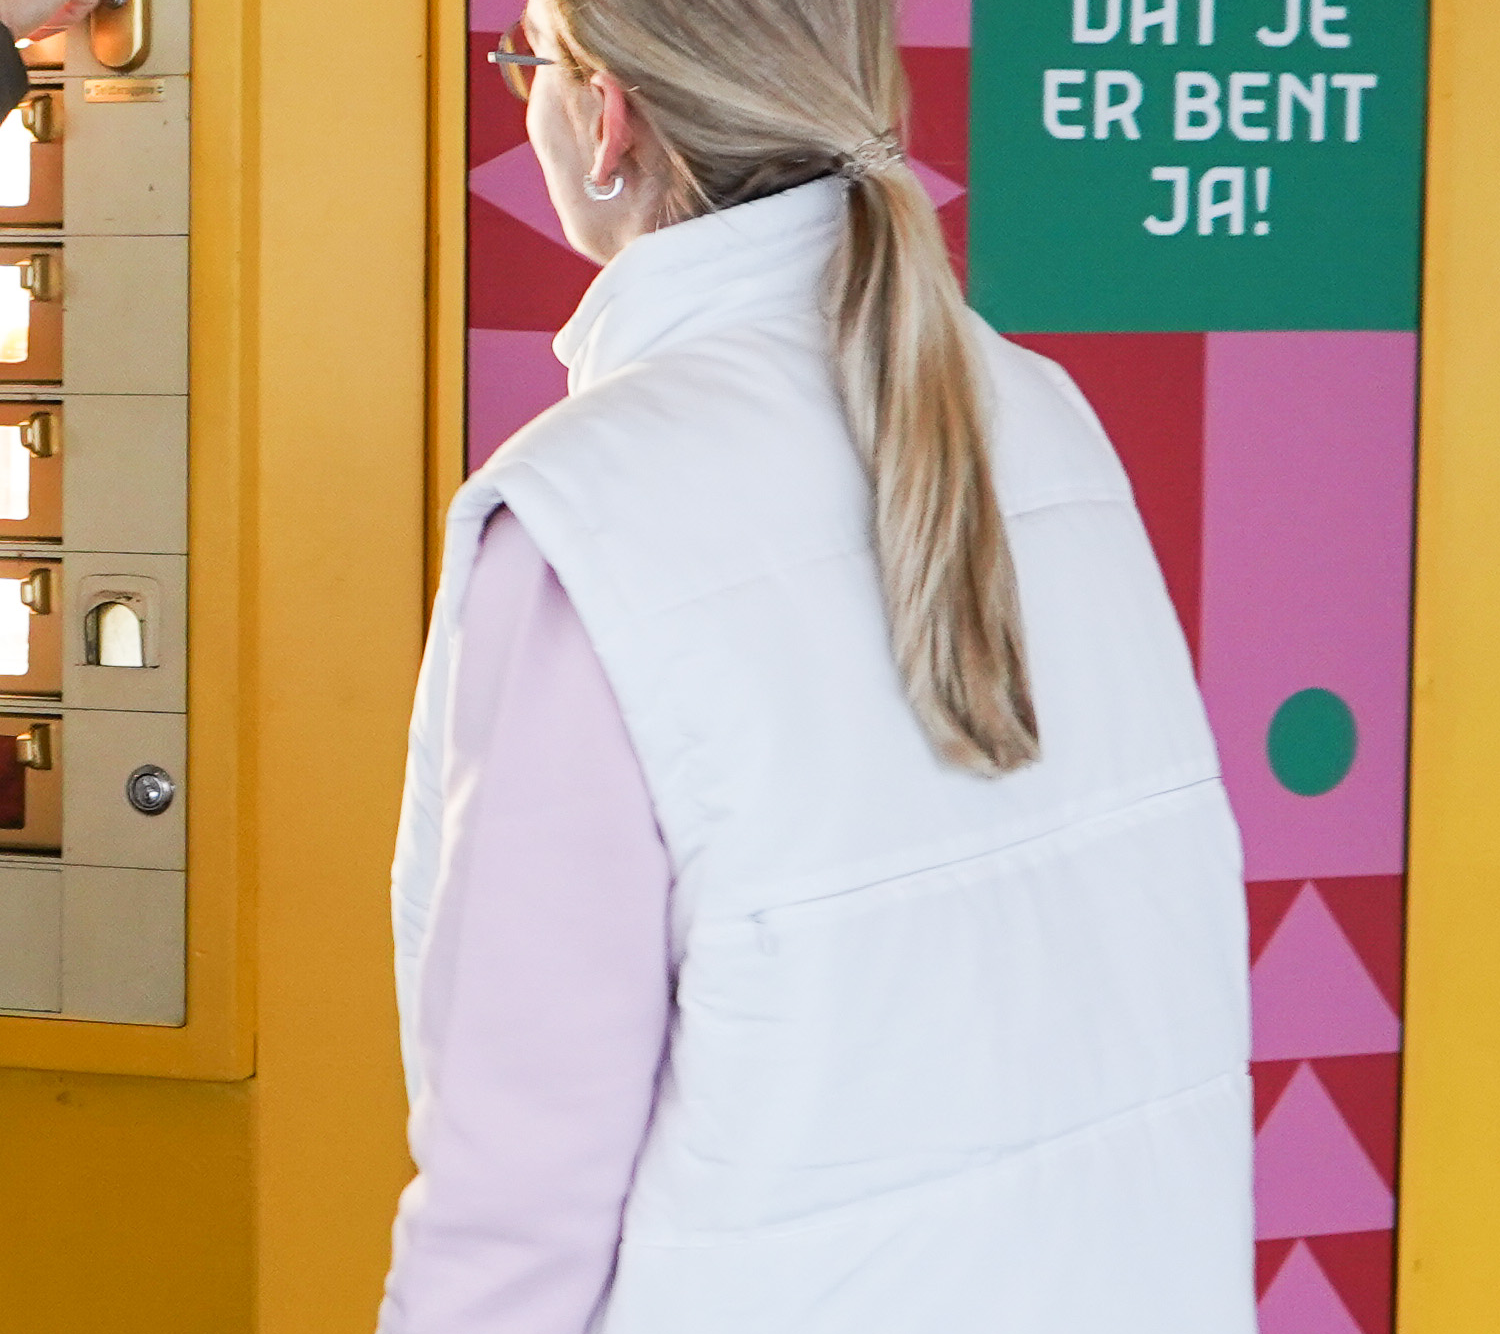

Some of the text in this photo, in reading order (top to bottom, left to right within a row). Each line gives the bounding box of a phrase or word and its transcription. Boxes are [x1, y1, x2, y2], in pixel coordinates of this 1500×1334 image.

[1043, 69, 1377, 143] ER BENT
[1143, 166, 1271, 236] JA!
